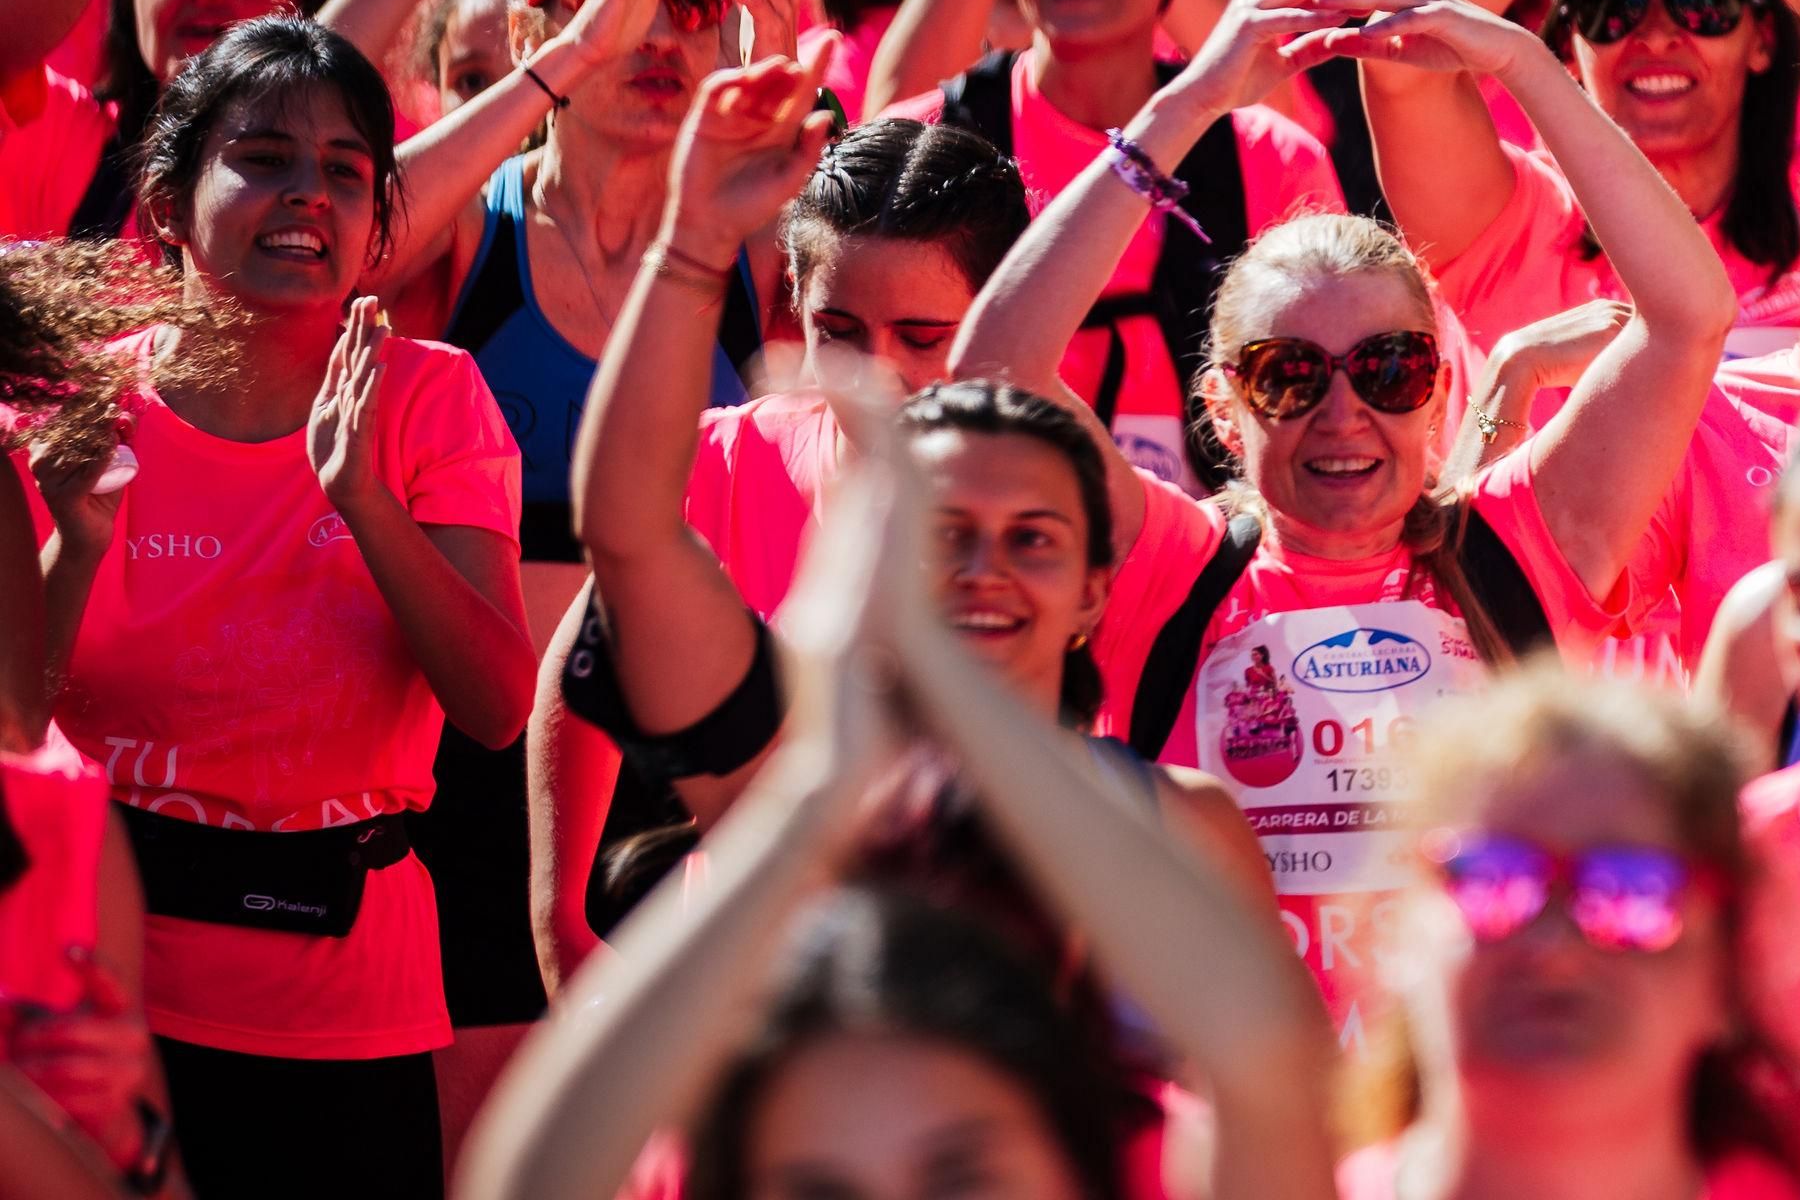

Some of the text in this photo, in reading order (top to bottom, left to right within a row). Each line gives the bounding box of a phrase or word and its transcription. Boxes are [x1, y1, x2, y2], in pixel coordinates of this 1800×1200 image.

[126, 533, 222, 560] YSHO
[1303, 656, 1422, 679] ASTURIANA
[105, 736, 179, 789] TU
[1247, 811, 1330, 830] CARRERA
[1333, 809, 1360, 826] DE
[1363, 809, 1388, 825] LA
[1266, 850, 1332, 873] YSHO
[277, 899, 327, 918] Kalenji
